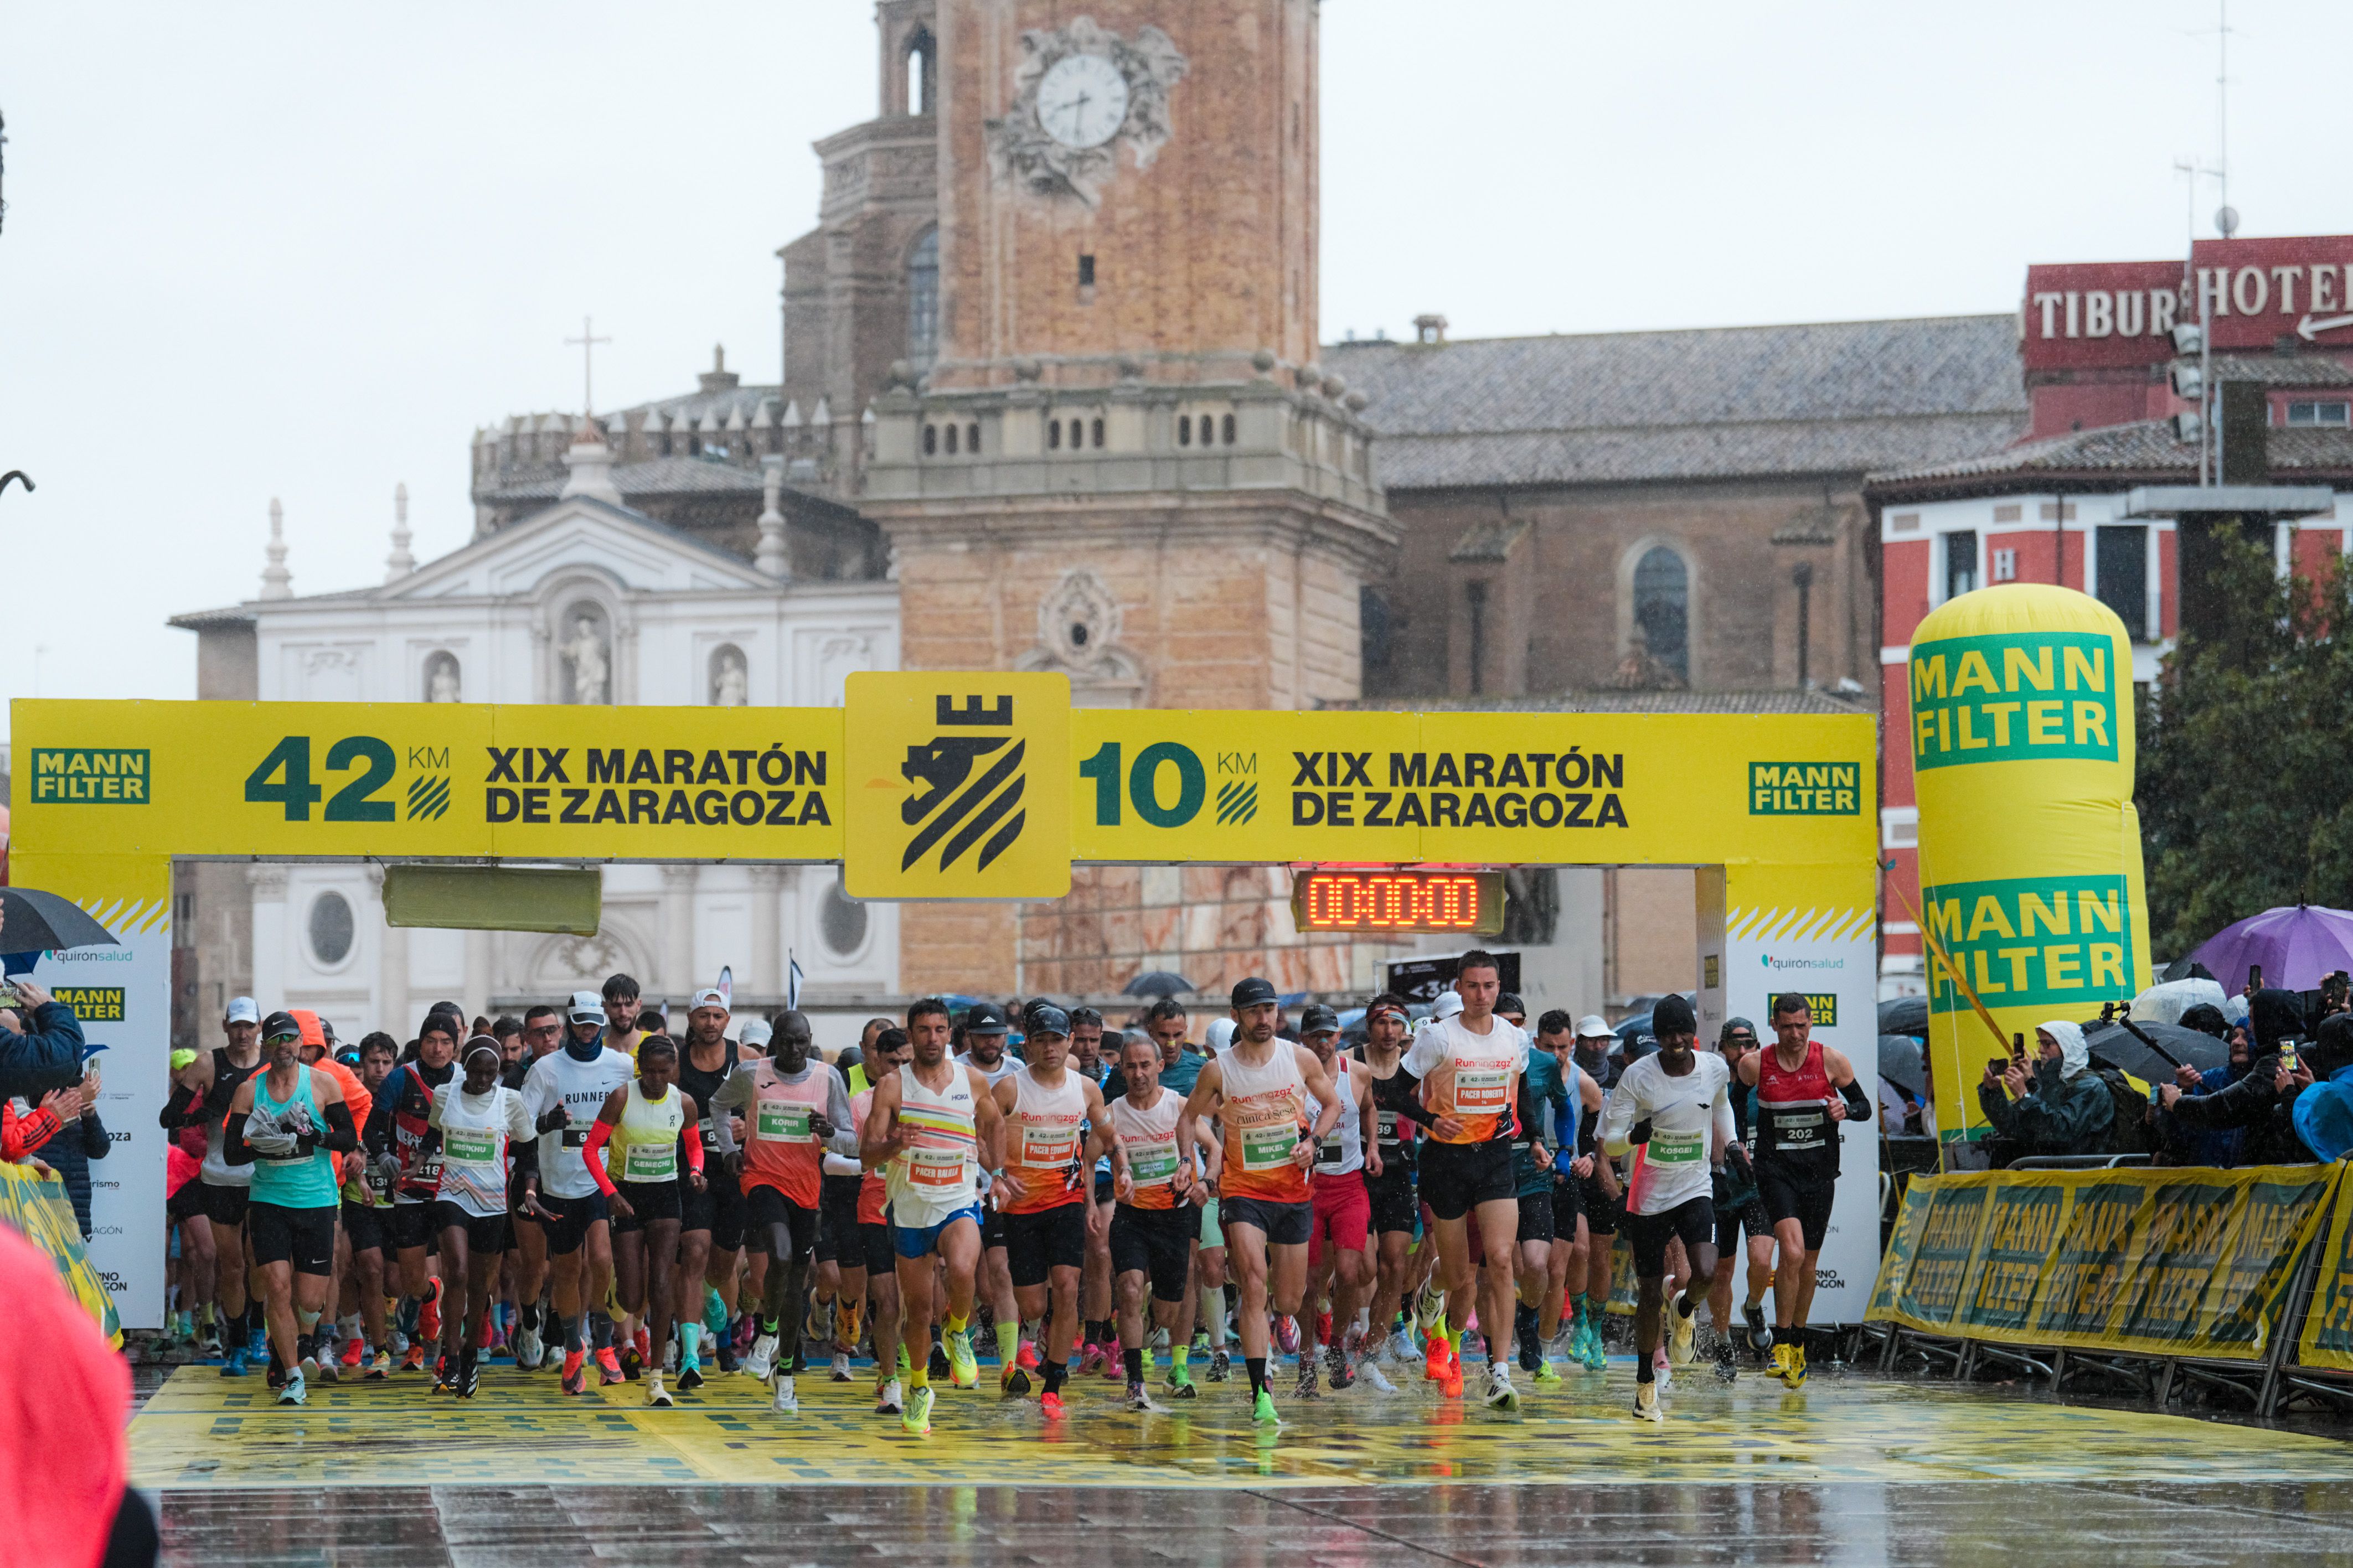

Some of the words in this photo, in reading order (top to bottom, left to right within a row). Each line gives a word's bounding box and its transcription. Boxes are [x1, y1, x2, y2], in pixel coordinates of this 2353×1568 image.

[2034, 288, 2177, 339] TIBUR
[1914, 646, 2106, 703] MANN
[1917, 700, 2110, 755] FILTER
[38, 753, 144, 775] MANN
[486, 747, 570, 783] XIX
[587, 742, 827, 786] MARATÓN
[1291, 751, 1373, 787] XIX
[1390, 746, 1624, 789] MARATÓN
[38, 777, 144, 799] FILTER
[245, 736, 396, 822] 42
[409, 747, 450, 769] KM
[1079, 741, 1206, 828] 10
[1218, 752, 1257, 774] KM
[1755, 767, 1854, 788] MANN
[486, 788, 550, 823] DE
[560, 789, 832, 826] ZARAGOZA
[1755, 789, 1855, 810] FILTER
[1292, 792, 1355, 826] DE
[1363, 793, 1629, 829] ZARAGOZA
[1309, 876, 1478, 927] 00:00:00
[1928, 889, 2121, 942] MANN
[57, 951, 132, 964] quirónsalud
[1773, 958, 1843, 971] quirónsalud
[1931, 942, 2127, 998] FILTER
[55, 990, 121, 1003] MANN
[1772, 996, 1833, 1010] NN
[70, 1005, 121, 1018] LTER
[1461, 1090, 1480, 1099] PACER
[1482, 1089, 1504, 1099] ROBERTO
[772, 1119, 798, 1127] KORIR
[1788, 1129, 1813, 1139] 202
[452, 1143, 486, 1153] MISIKHU
[1030, 1145, 1049, 1155] PACER
[1258, 1144, 1284, 1153] MIKEL
[916, 1167, 936, 1178] PACER
[92, 1225, 122, 1235] AGÓN
